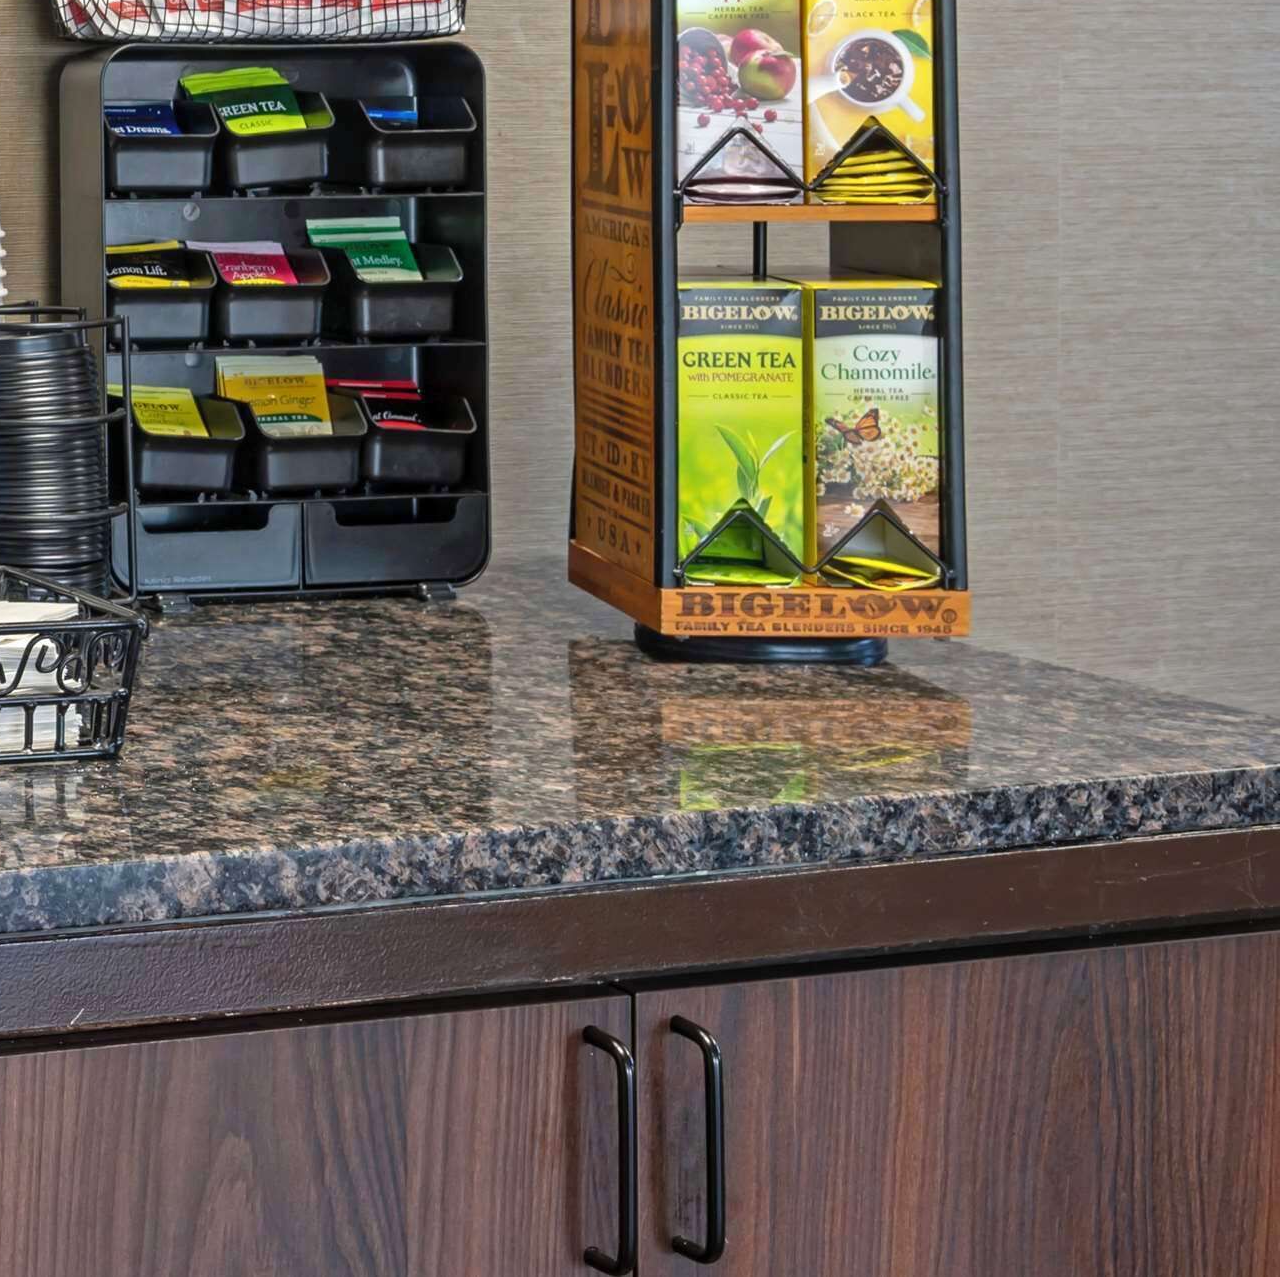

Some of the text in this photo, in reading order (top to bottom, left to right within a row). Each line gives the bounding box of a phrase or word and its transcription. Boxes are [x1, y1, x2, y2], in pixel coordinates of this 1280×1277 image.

[843, 11, 877, 19] BLACK
[259, 101, 287, 112] TEA
[681, 305, 797, 320] BIGELOW
[819, 305, 933, 321] BIGELOW
[582, 323, 651, 370] FAMILY TEA
[682, 351, 797, 369] GREEN TEA
[853, 345, 902, 367] Cozy
[582, 353, 650, 398] BLENDERS
[687, 373, 794, 383] with POMEGRANATE
[821, 363, 932, 380] Chamomile
[280, 395, 316, 410] Ginger
[676, 591, 950, 620] BIGELOW
[676, 621, 729, 632] FAMILY
[737, 621, 766, 633] TEA
[772, 622, 855, 633] BLENDERS
[863, 623, 909, 634] SINCE
